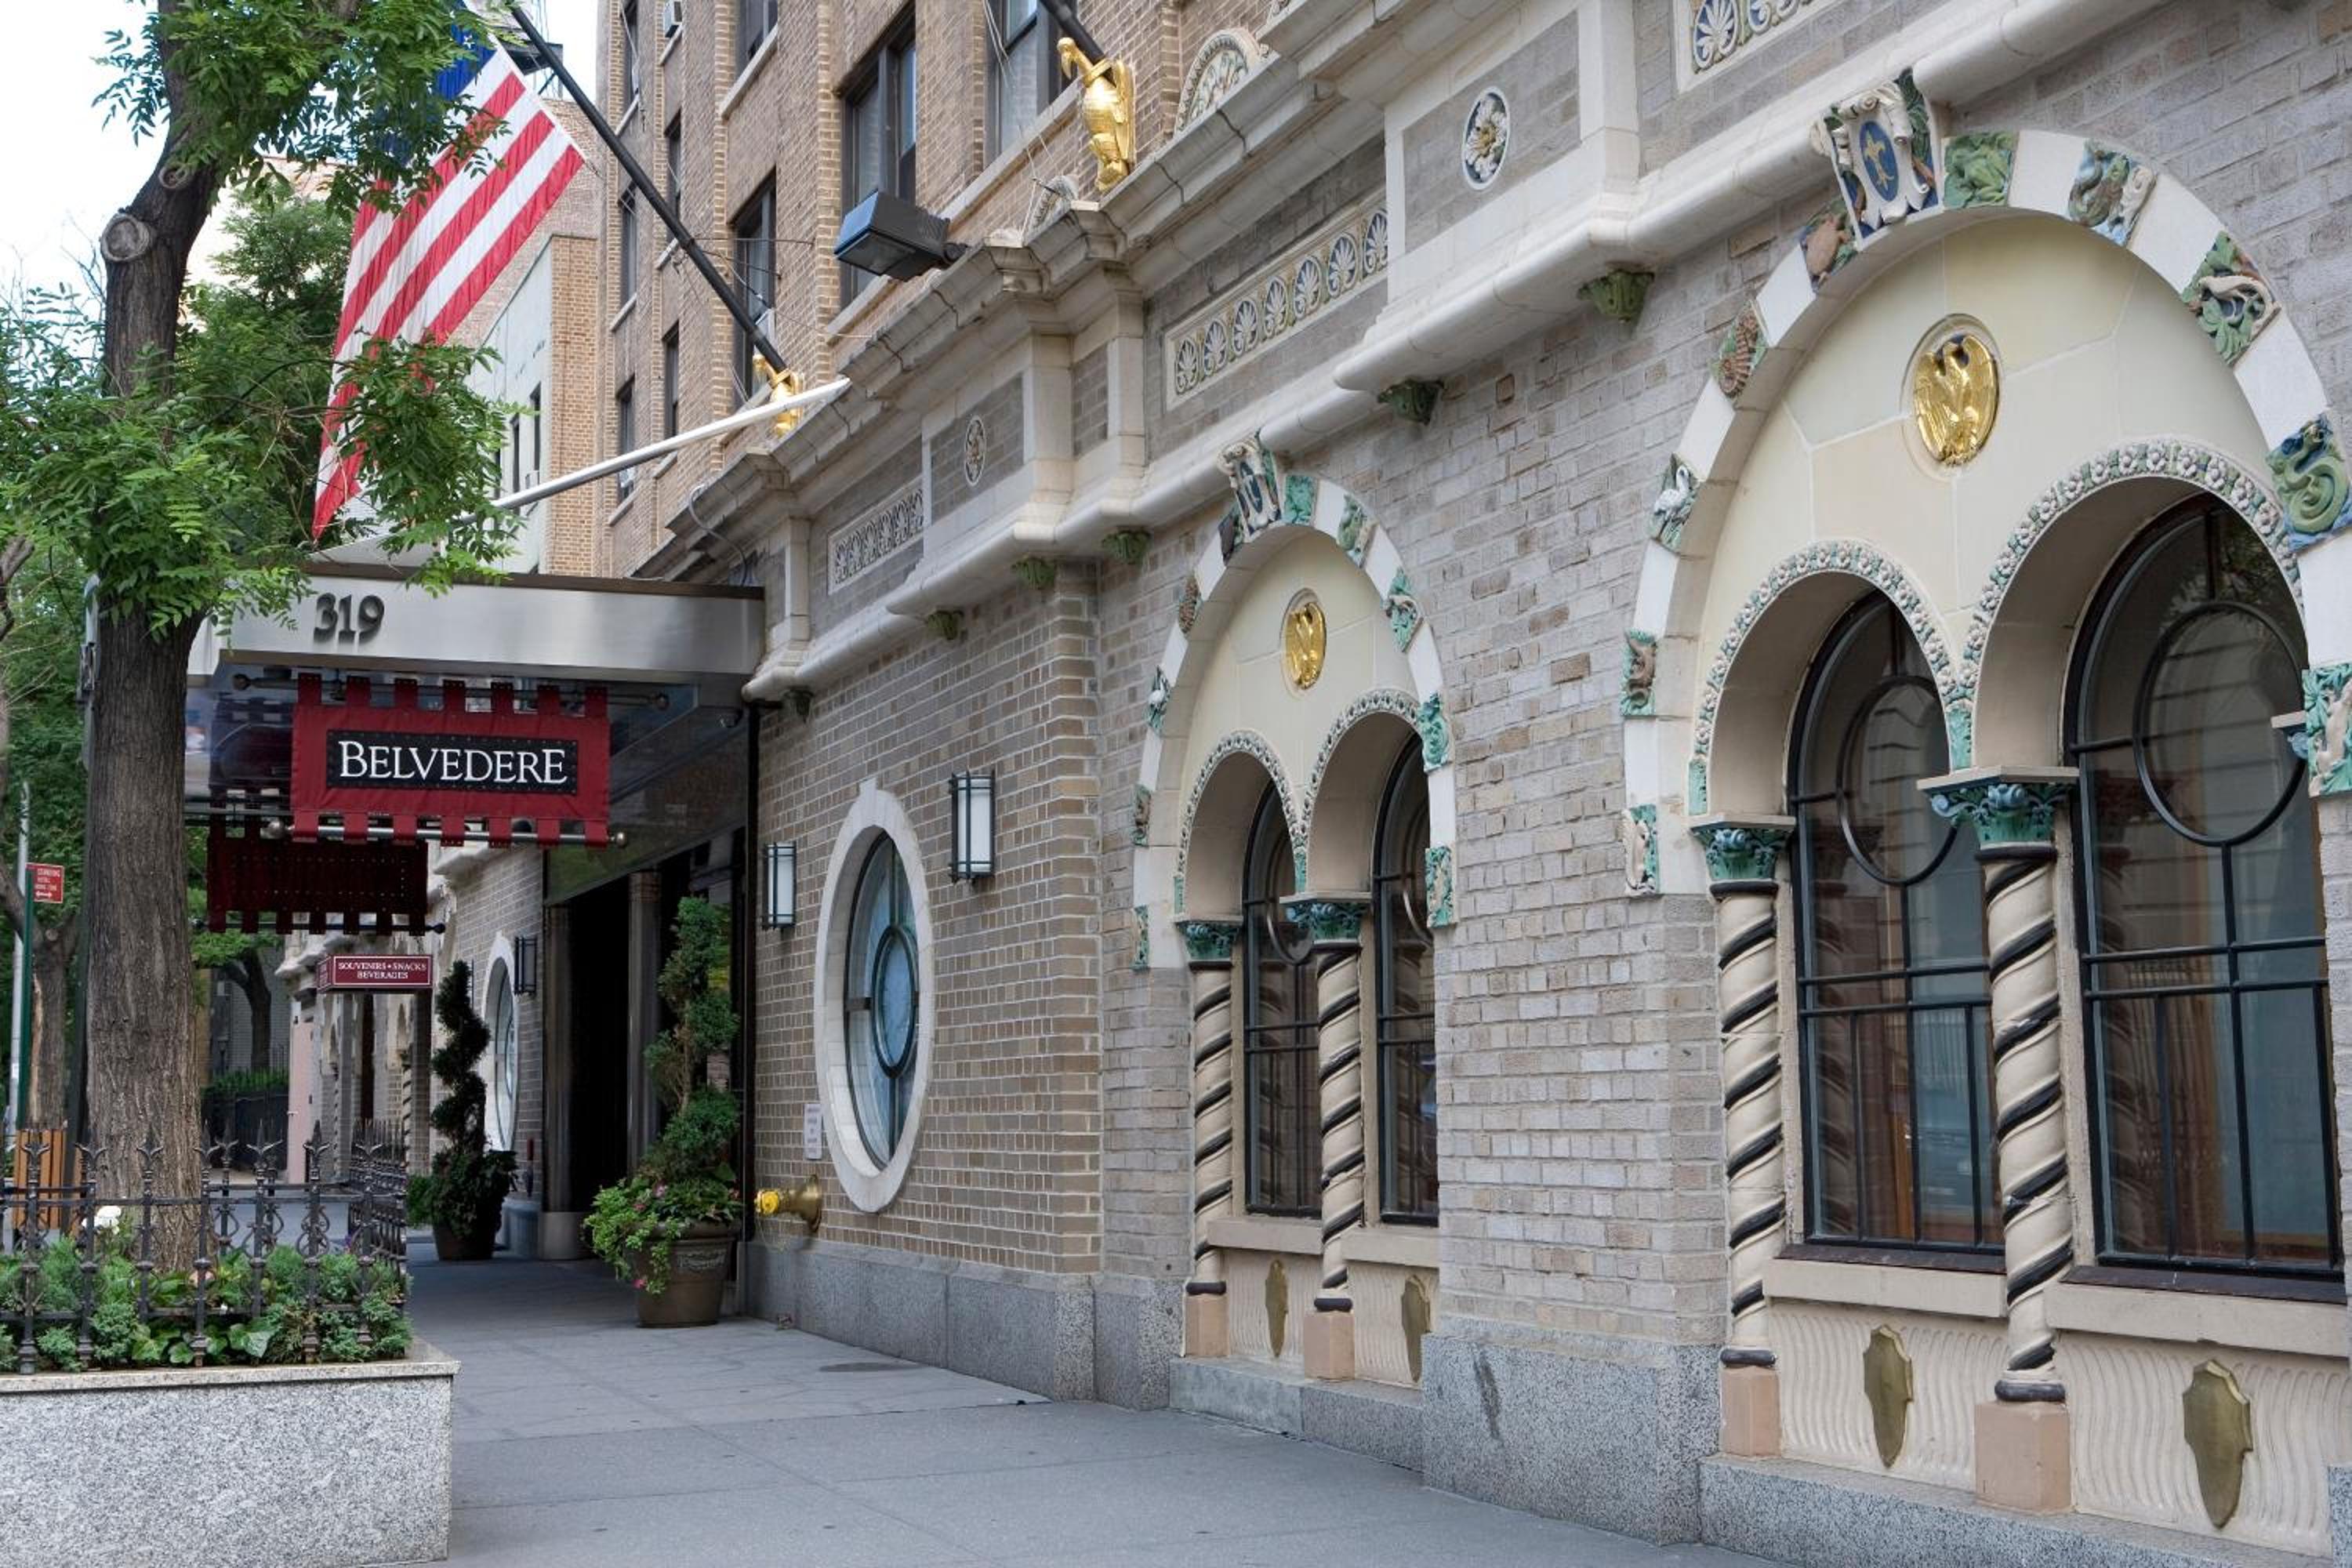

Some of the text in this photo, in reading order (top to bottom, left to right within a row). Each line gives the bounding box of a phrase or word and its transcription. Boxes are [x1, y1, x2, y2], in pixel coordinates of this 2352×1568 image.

[314, 592, 385, 644] 319
[338, 741, 568, 784] BELVEDERE
[338, 962, 427, 971] SOUVENIRS SNACKS
